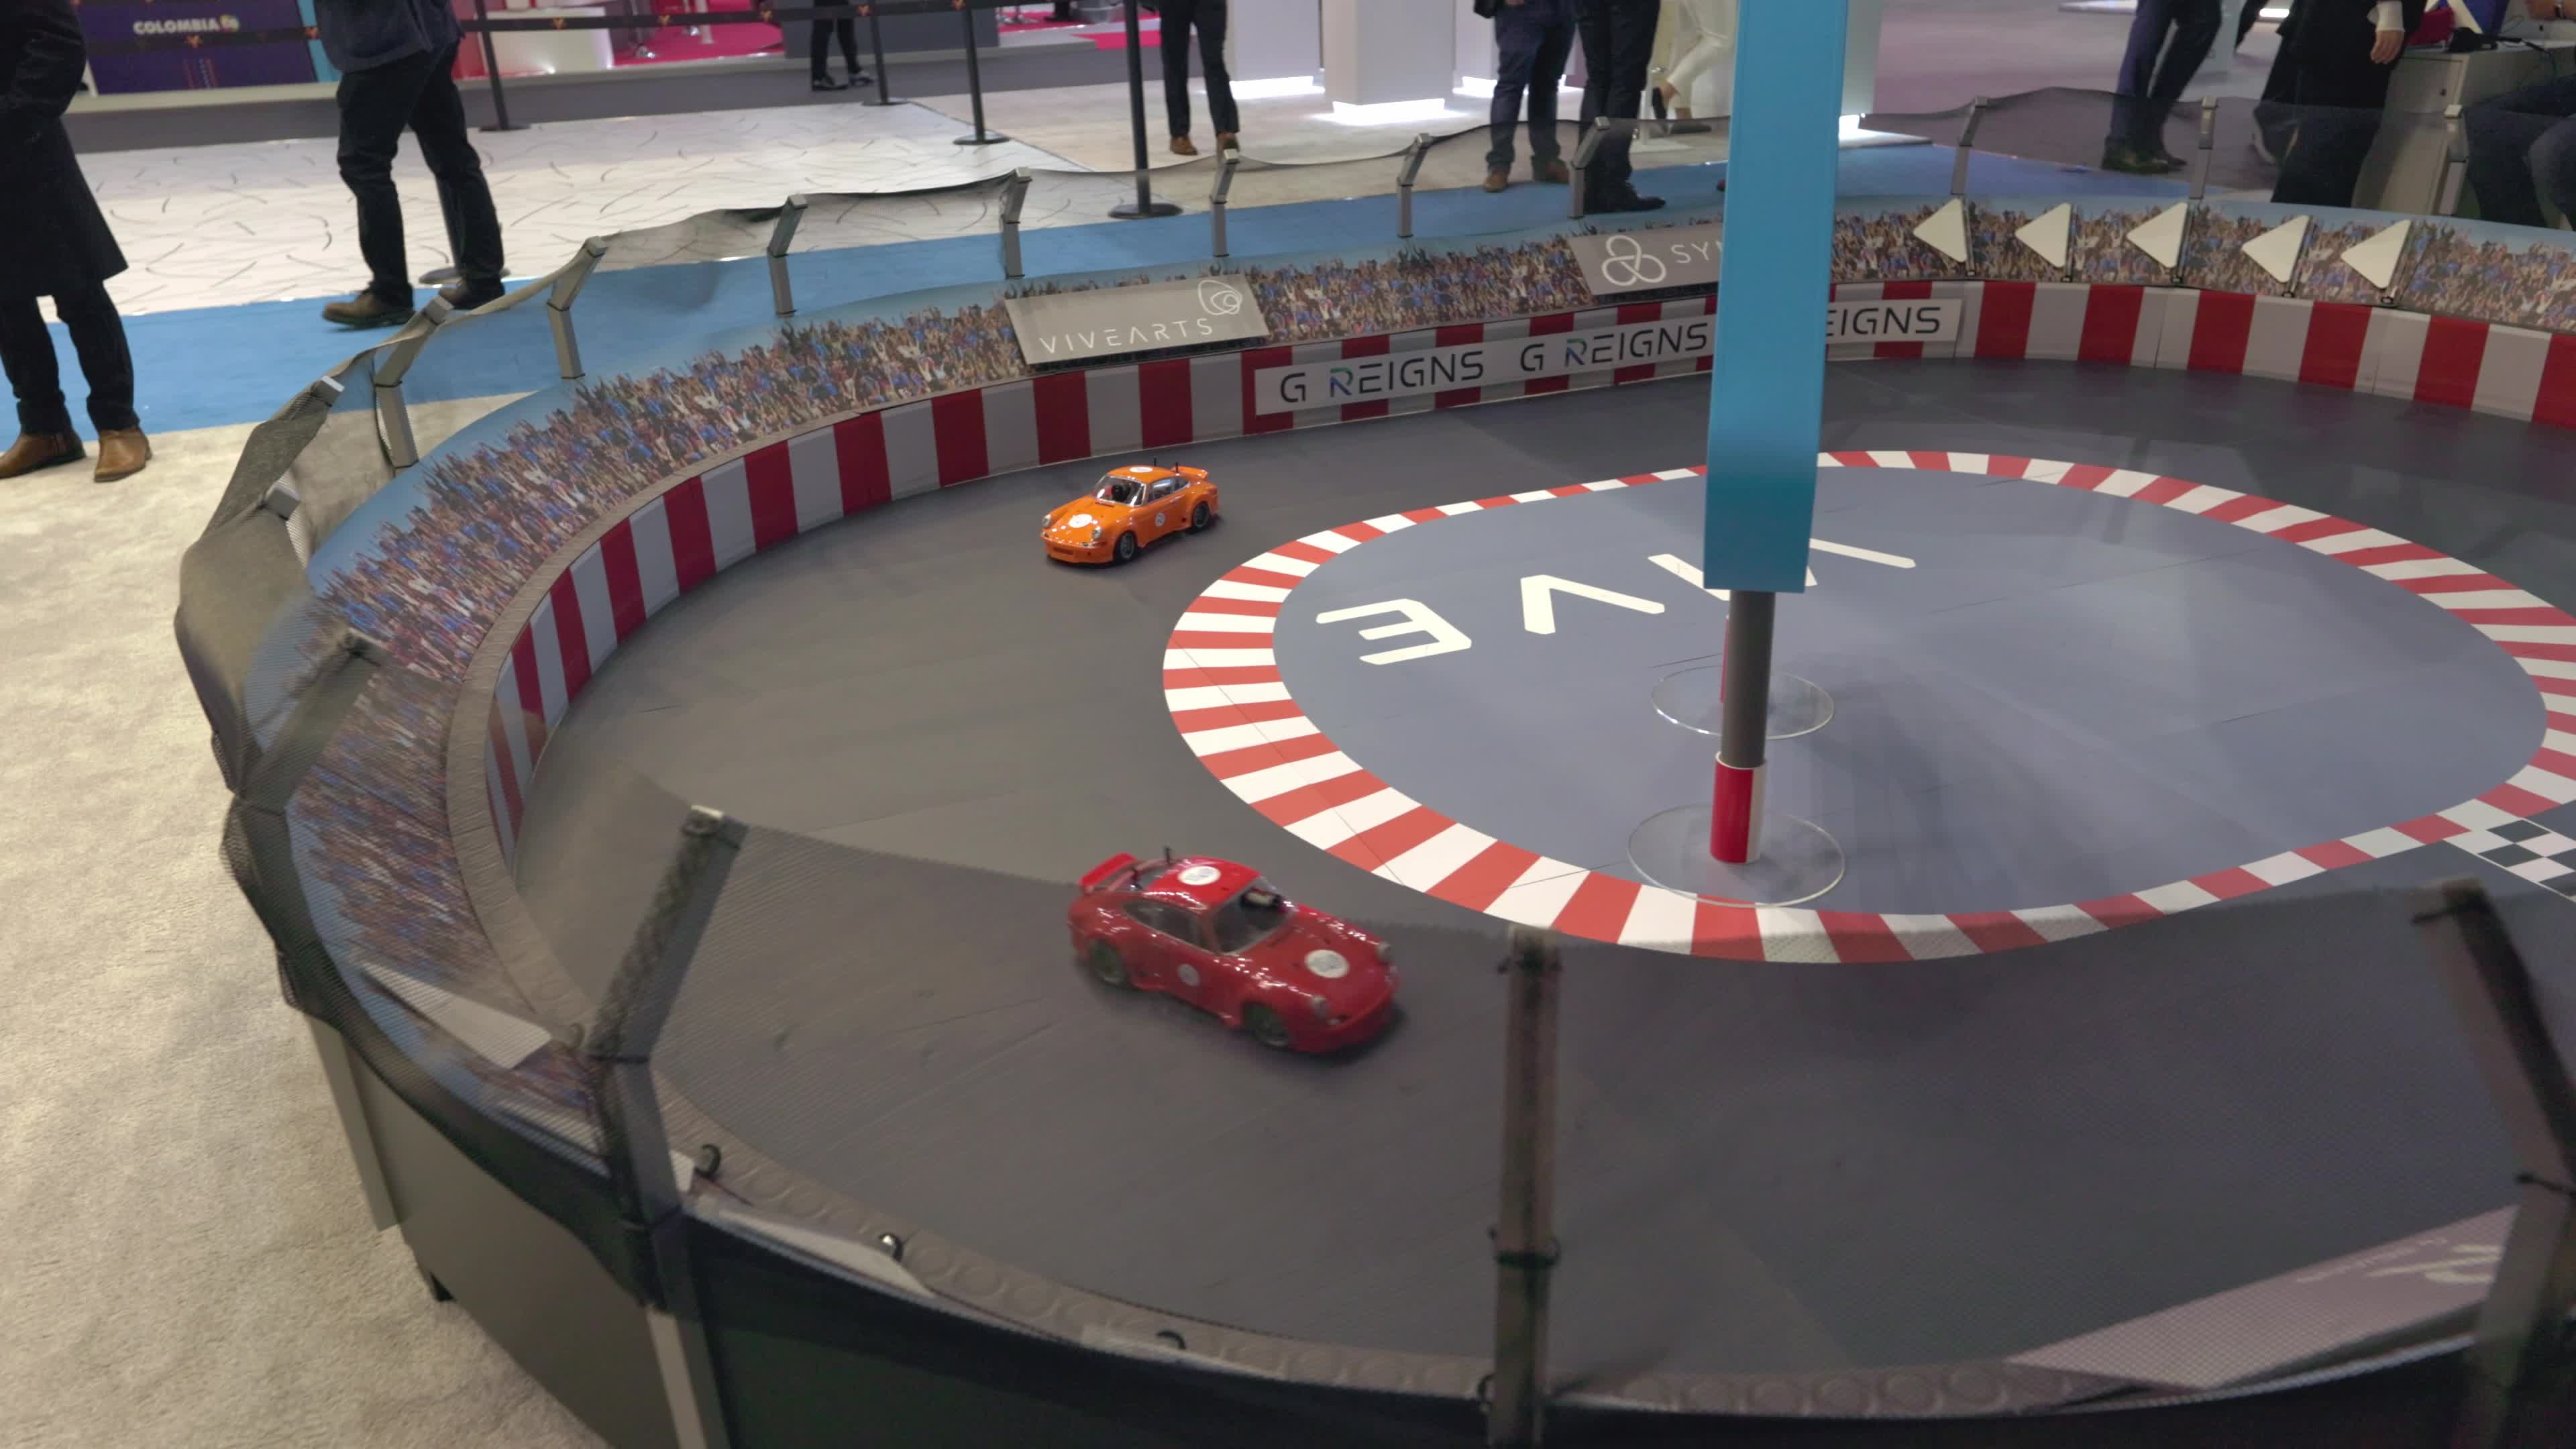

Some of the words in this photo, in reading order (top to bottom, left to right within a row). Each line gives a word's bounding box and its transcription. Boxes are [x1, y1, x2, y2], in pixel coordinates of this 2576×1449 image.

[133, 18, 220, 34] COLOMBIA
[1280, 372, 1306, 403] G
[1330, 350, 1484, 398] REIGNS
[1520, 343, 1544, 372] G
[1565, 323, 1708, 367] REIGNS
